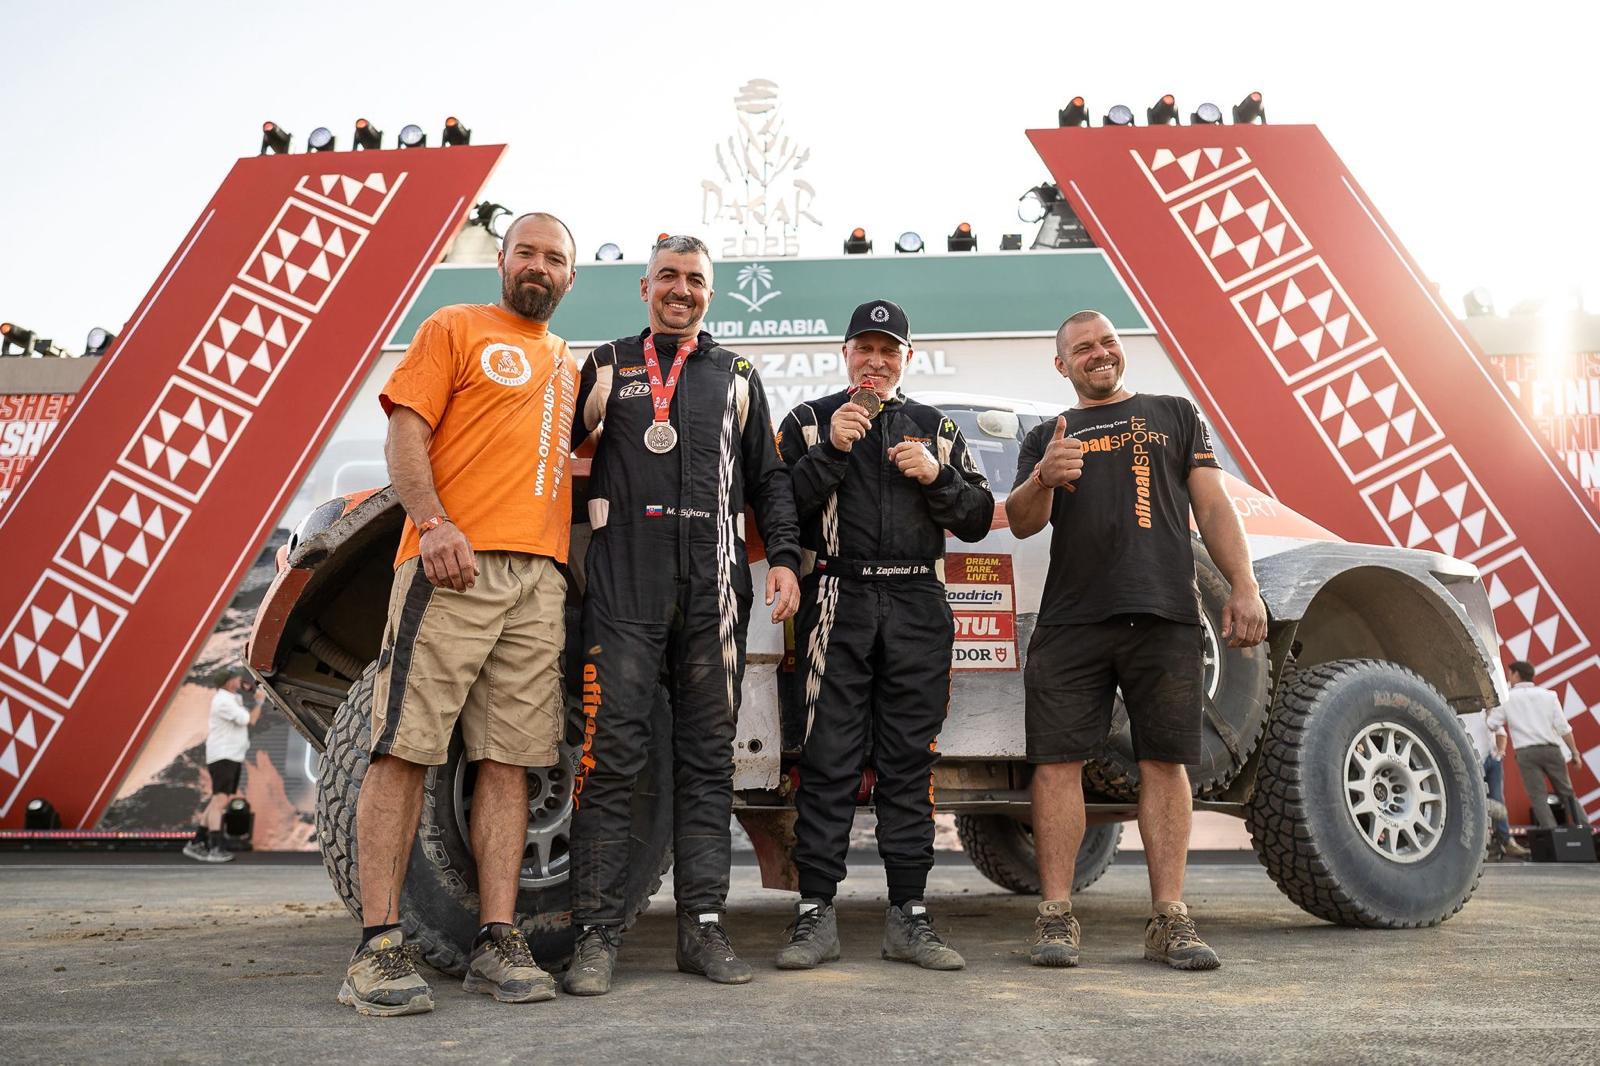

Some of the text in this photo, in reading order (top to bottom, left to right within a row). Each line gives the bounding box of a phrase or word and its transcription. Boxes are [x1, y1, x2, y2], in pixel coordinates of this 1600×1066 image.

[701, 179, 823, 226] DAKAR
[703, 319, 829, 337] UDI ARABIA
[0, 421, 60, 457] SH
[1081, 431, 1169, 454] oadSPORT
[666, 507, 676, 516] M.
[1233, 497, 1276, 517] ORT
[965, 557, 1001, 566] DREAM.
[862, 566, 873, 576] M.
[966, 565, 994, 574] DARE.
[966, 573, 988, 581] LIVE
[945, 590, 1003, 601] oodrich
[953, 648, 993, 661] DOR
